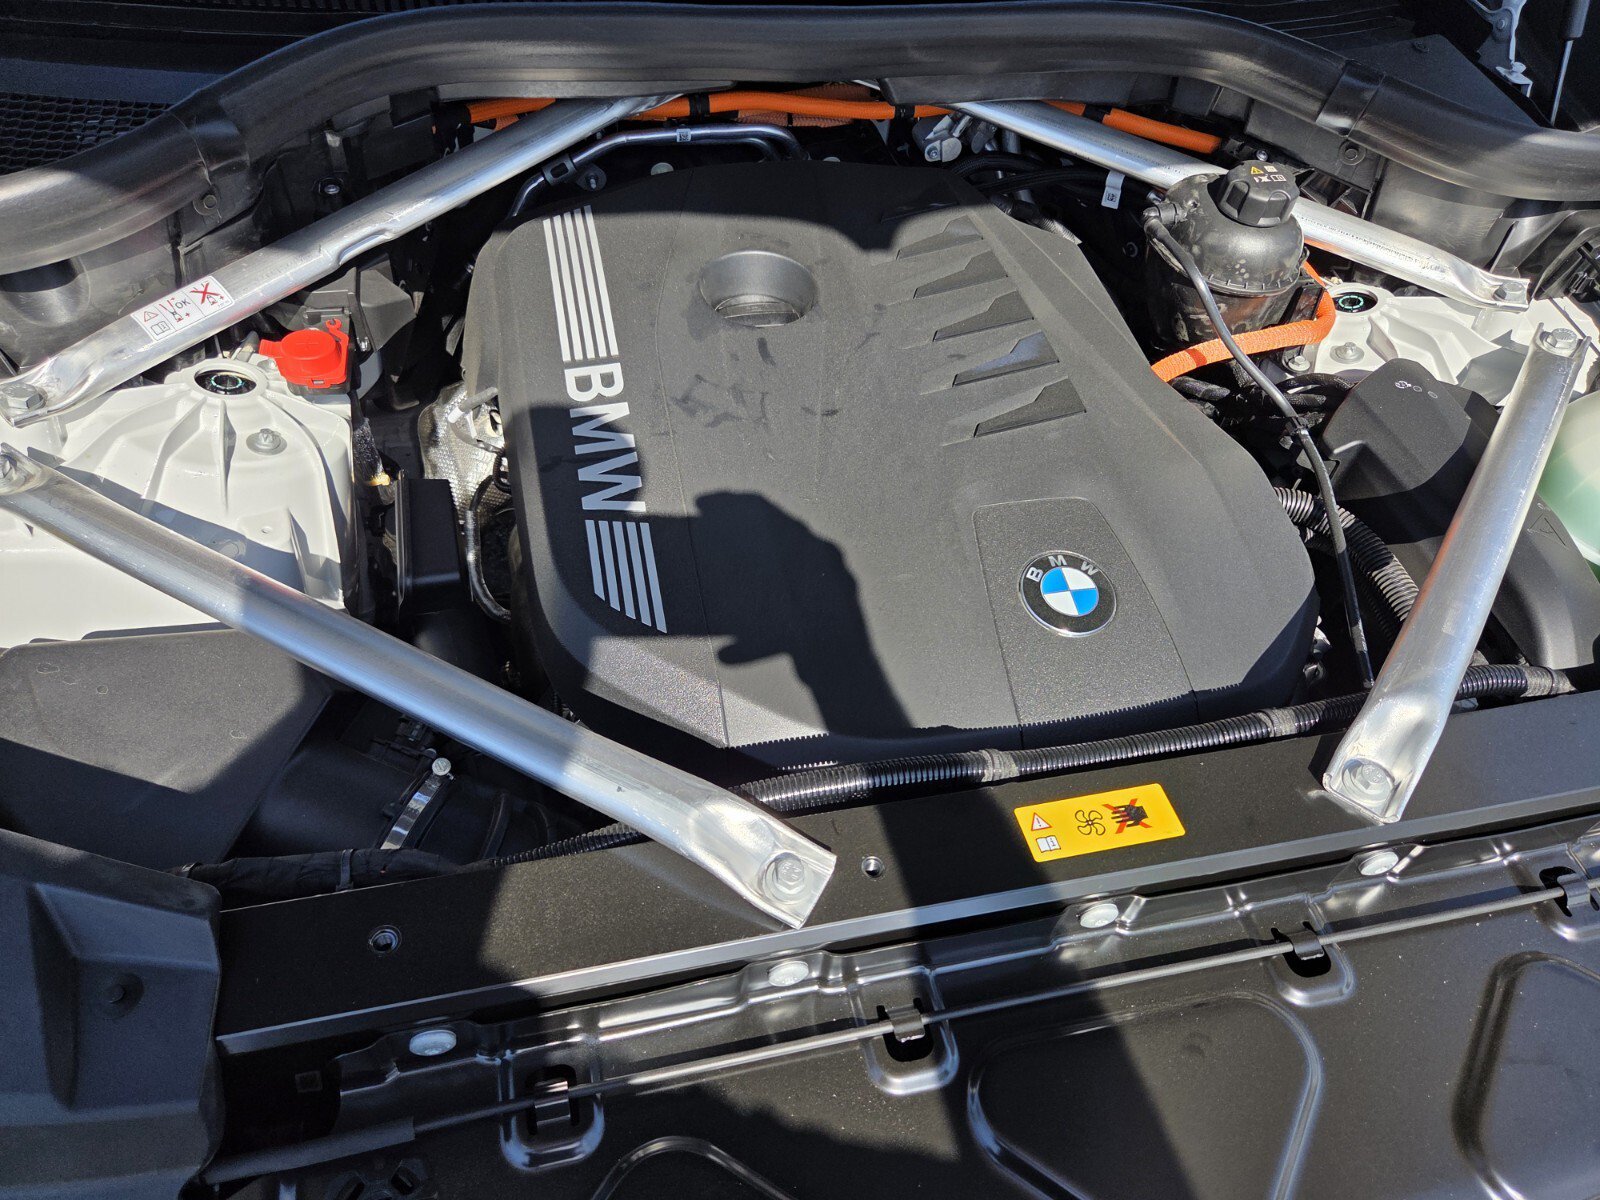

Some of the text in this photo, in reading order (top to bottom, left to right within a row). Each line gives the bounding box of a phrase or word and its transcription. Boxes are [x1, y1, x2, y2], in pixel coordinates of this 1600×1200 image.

[174, 298, 191, 310] OK
[564, 362, 647, 513] BMW
[1026, 554, 1099, 582] BMW
